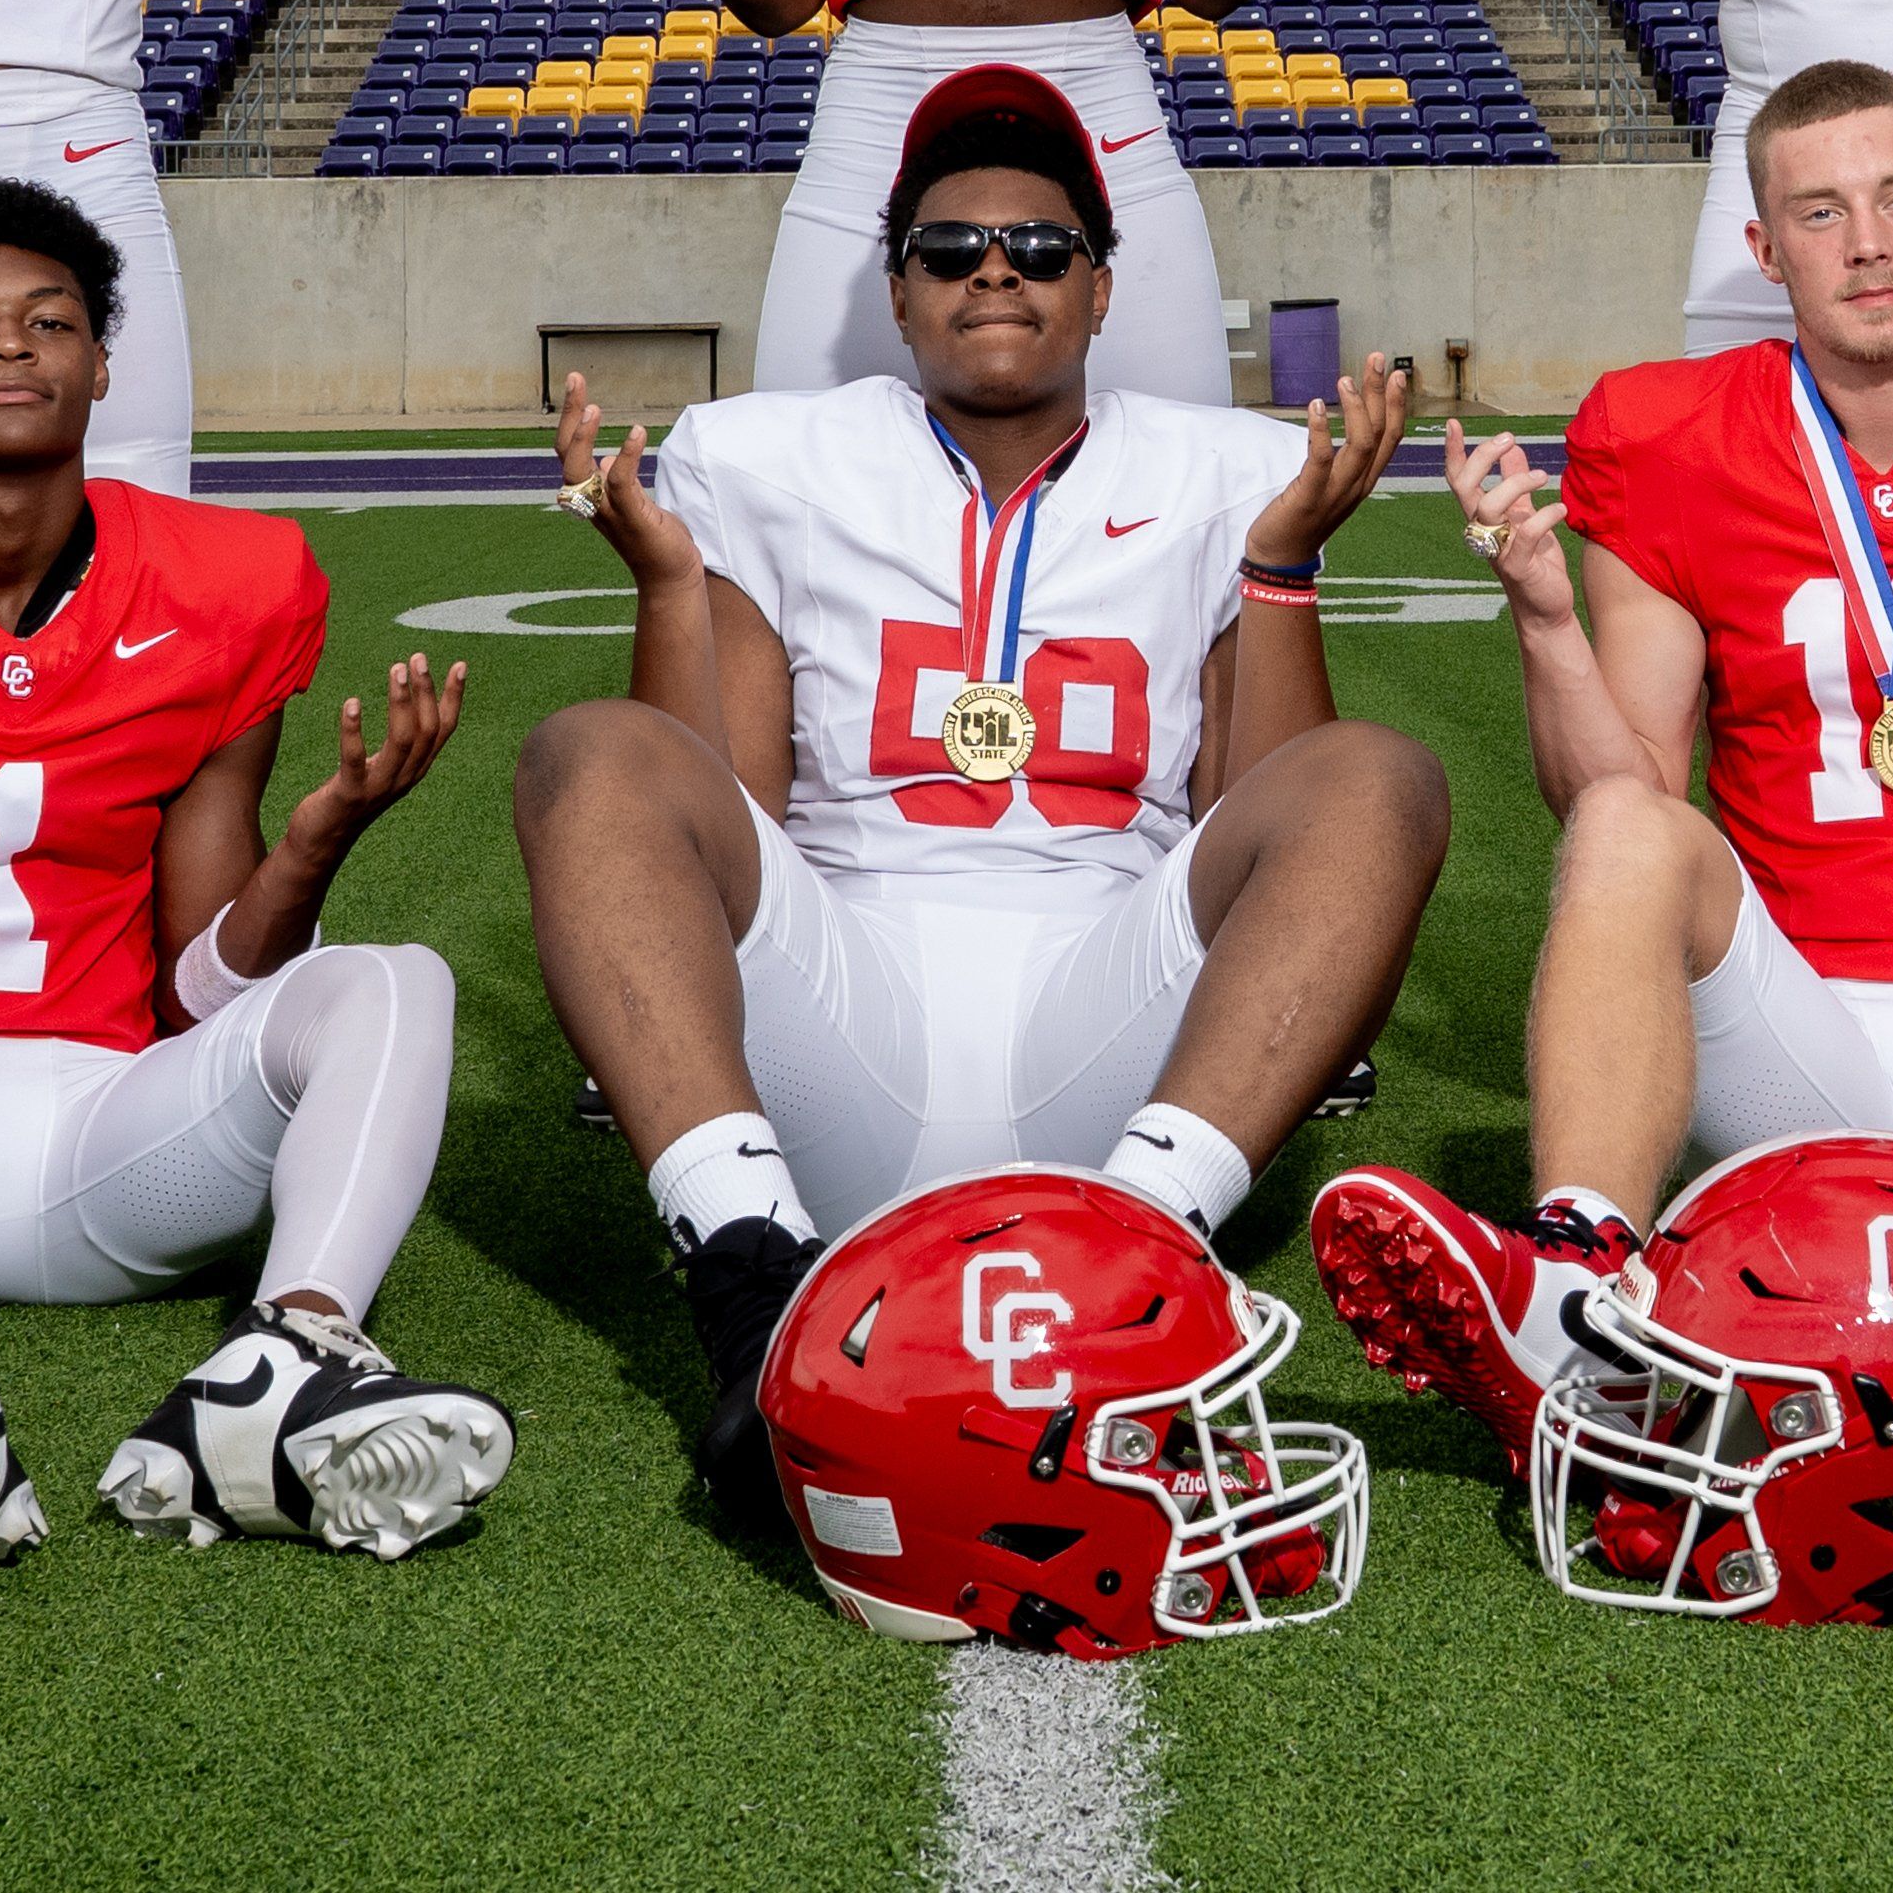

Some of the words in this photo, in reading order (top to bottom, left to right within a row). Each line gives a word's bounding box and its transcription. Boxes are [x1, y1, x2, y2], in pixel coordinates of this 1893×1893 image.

[2, 654, 34, 697] CC
[955, 687, 1034, 726] INTERSCHOLASTIC
[970, 749, 1007, 759] STATE
[962, 1251, 1075, 1409] CC
[1171, 1471, 1247, 1493] Ridell
